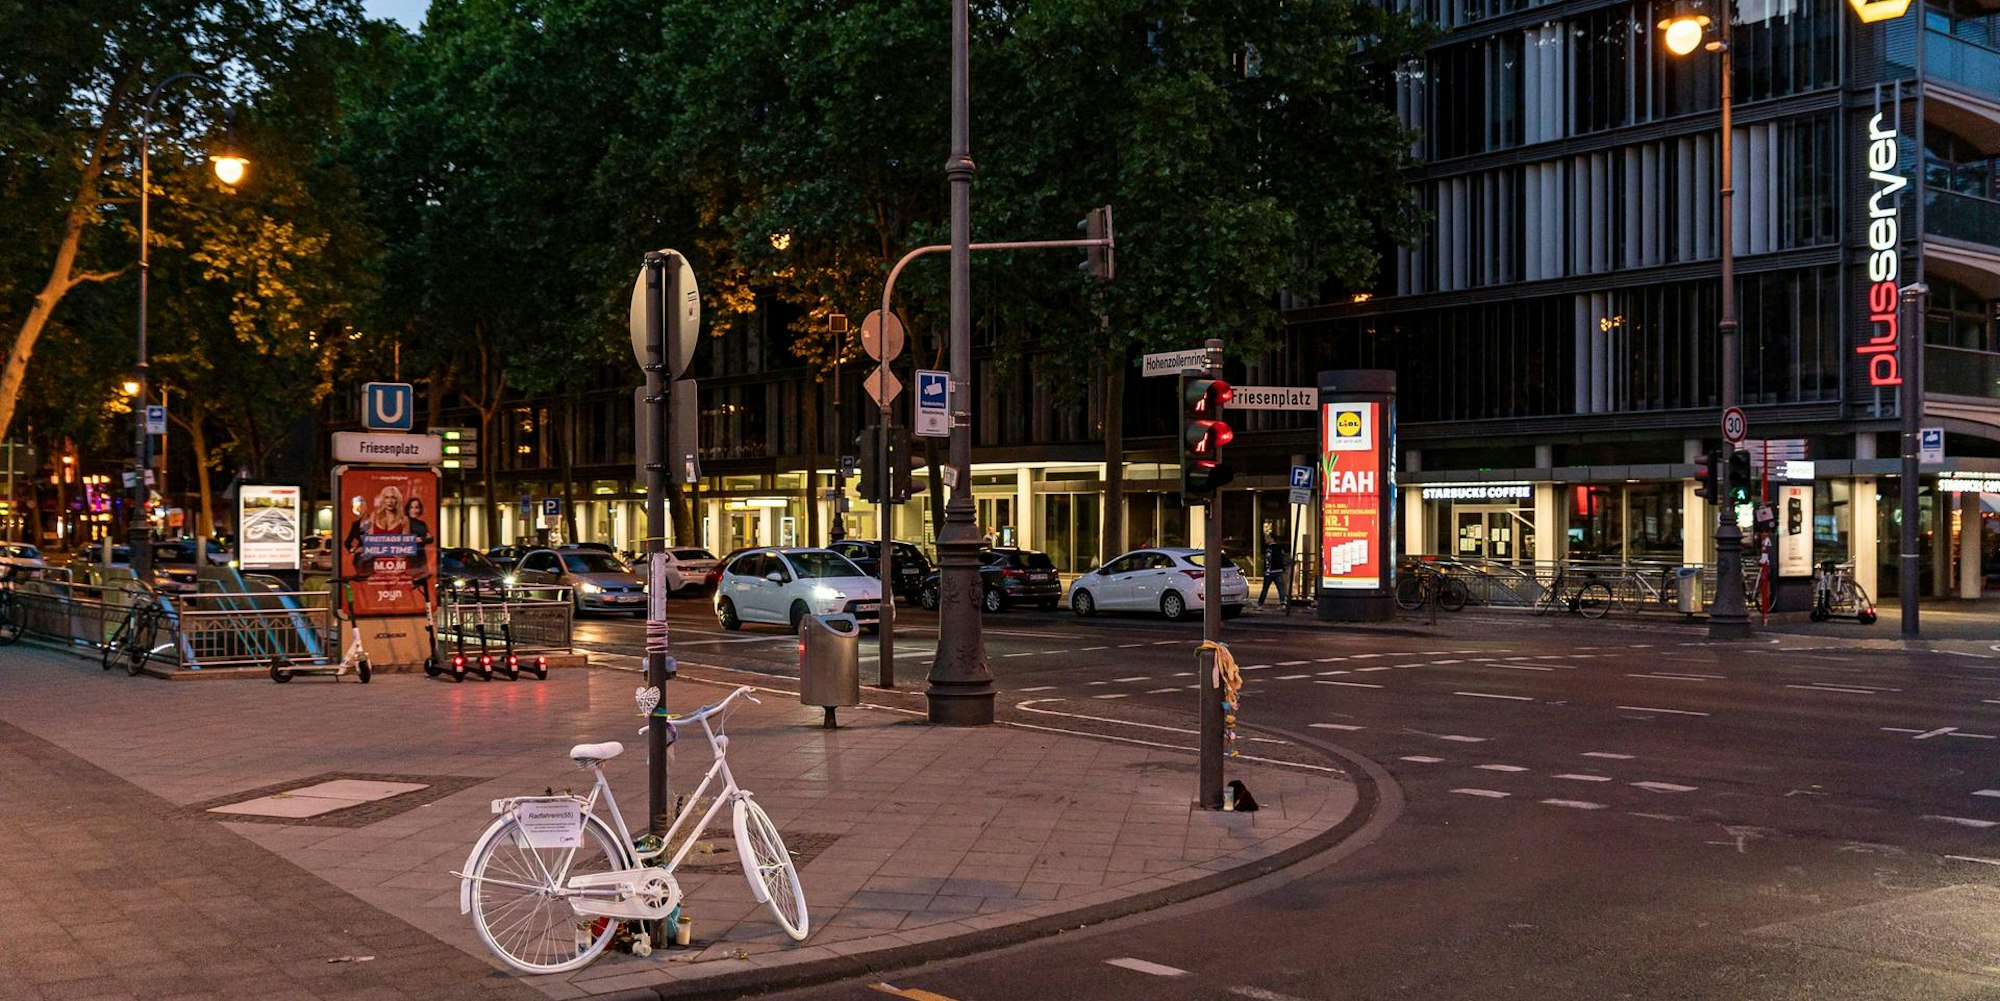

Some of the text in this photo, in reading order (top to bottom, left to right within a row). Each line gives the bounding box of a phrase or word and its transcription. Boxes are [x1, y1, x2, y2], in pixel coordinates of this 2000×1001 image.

[1856, 111, 1907, 386] plusserver
[1146, 352, 1206, 371] Hohenzollernring
[376, 389, 404, 423] U
[1231, 388, 1311, 408] Friesenplatz
[1727, 417, 1741, 433] 30
[360, 441, 419, 457] Friesenplatz
[1422, 486, 1531, 499] STARBUCKS COFFEE
[1325, 515, 1349, 526] NR. 1
[364, 535, 415, 543] FREITAGS IST
[363, 546, 389, 554] MILF
